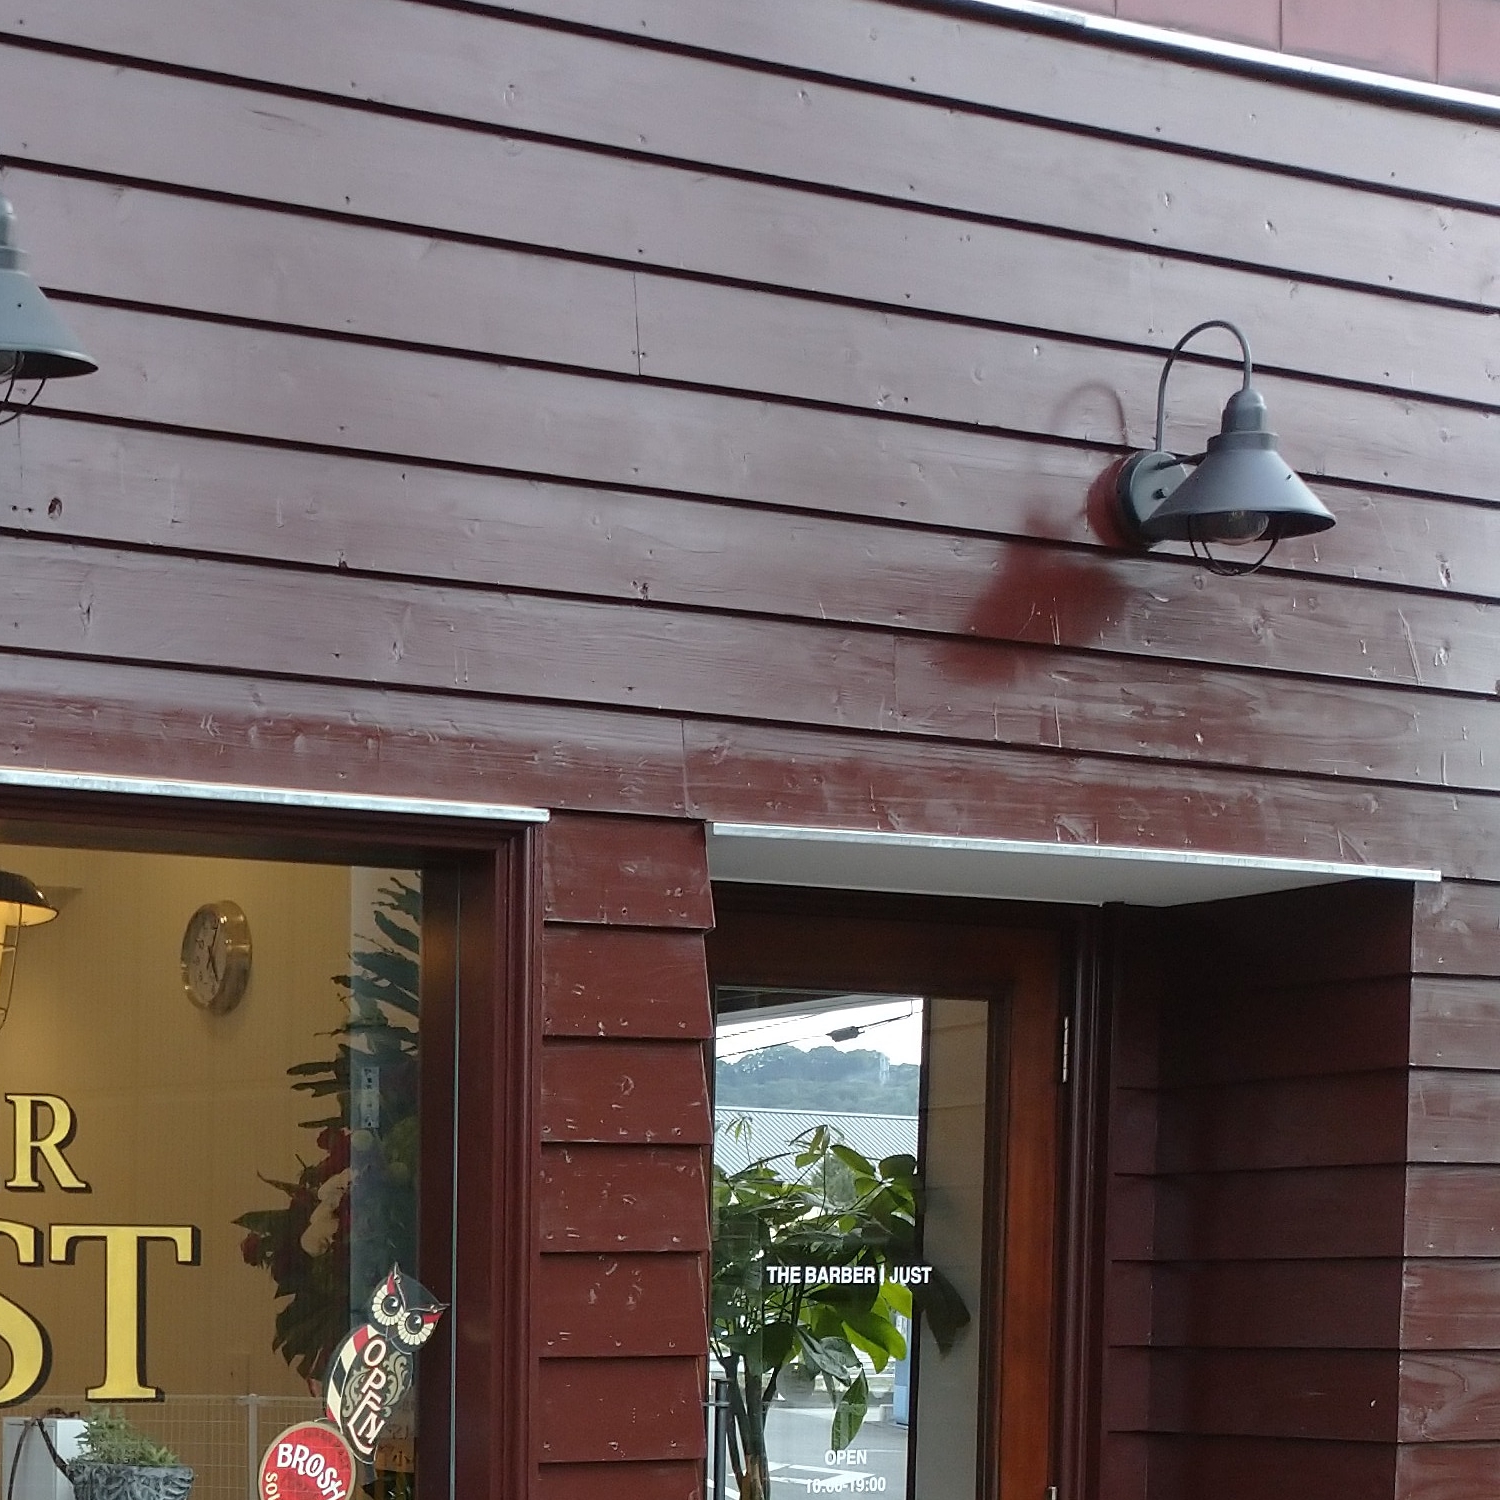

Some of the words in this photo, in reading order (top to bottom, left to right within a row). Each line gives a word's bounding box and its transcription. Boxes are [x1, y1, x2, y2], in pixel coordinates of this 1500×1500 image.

[766, 1266, 801, 1284] THE
[805, 1266, 876, 1285] BARBER
[889, 1266, 933, 1285] JUST
[347, 1338, 386, 1456] OPEN
[824, 1449, 867, 1466] OPEN
